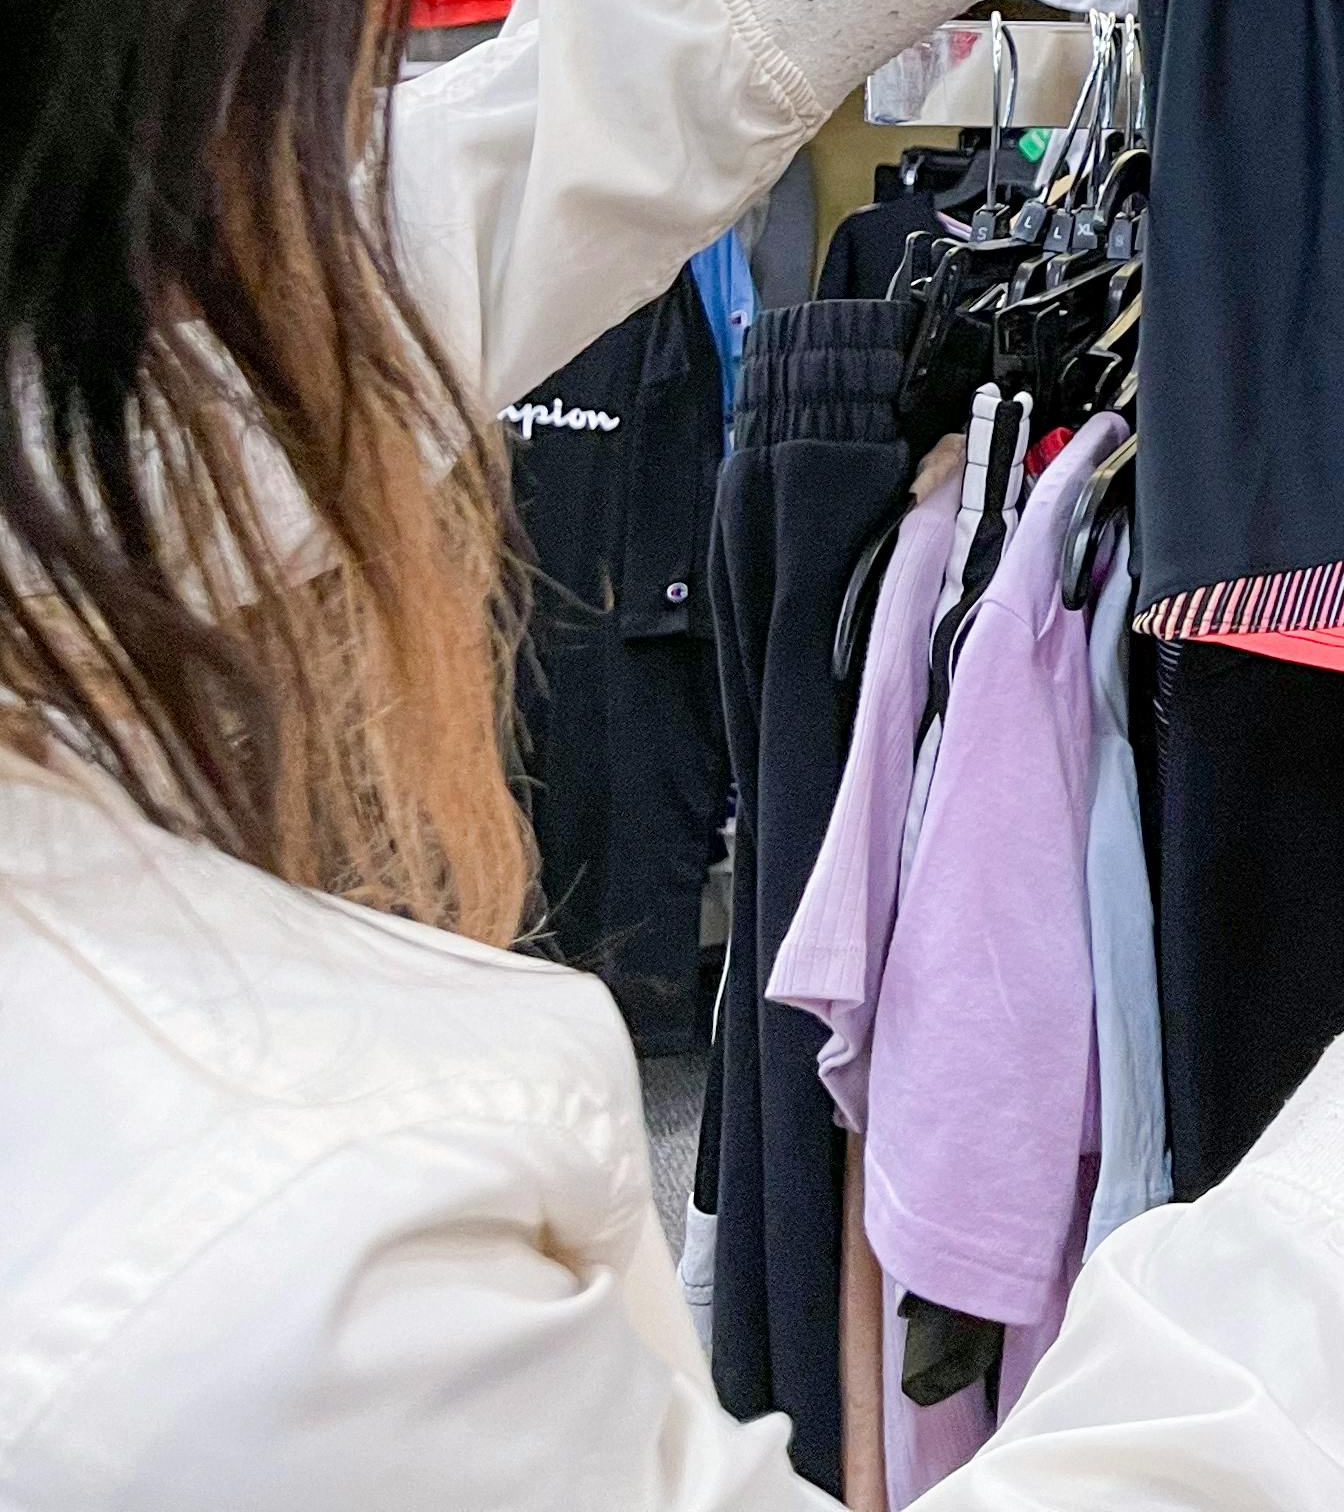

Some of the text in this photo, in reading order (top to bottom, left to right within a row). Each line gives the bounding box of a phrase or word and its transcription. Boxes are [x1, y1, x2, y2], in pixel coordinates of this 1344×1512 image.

[1024, 216, 1032, 229] L
[1053, 226, 1062, 239] L
[1077, 223, 1094, 236] XL
[497, 397, 620, 439] pion
